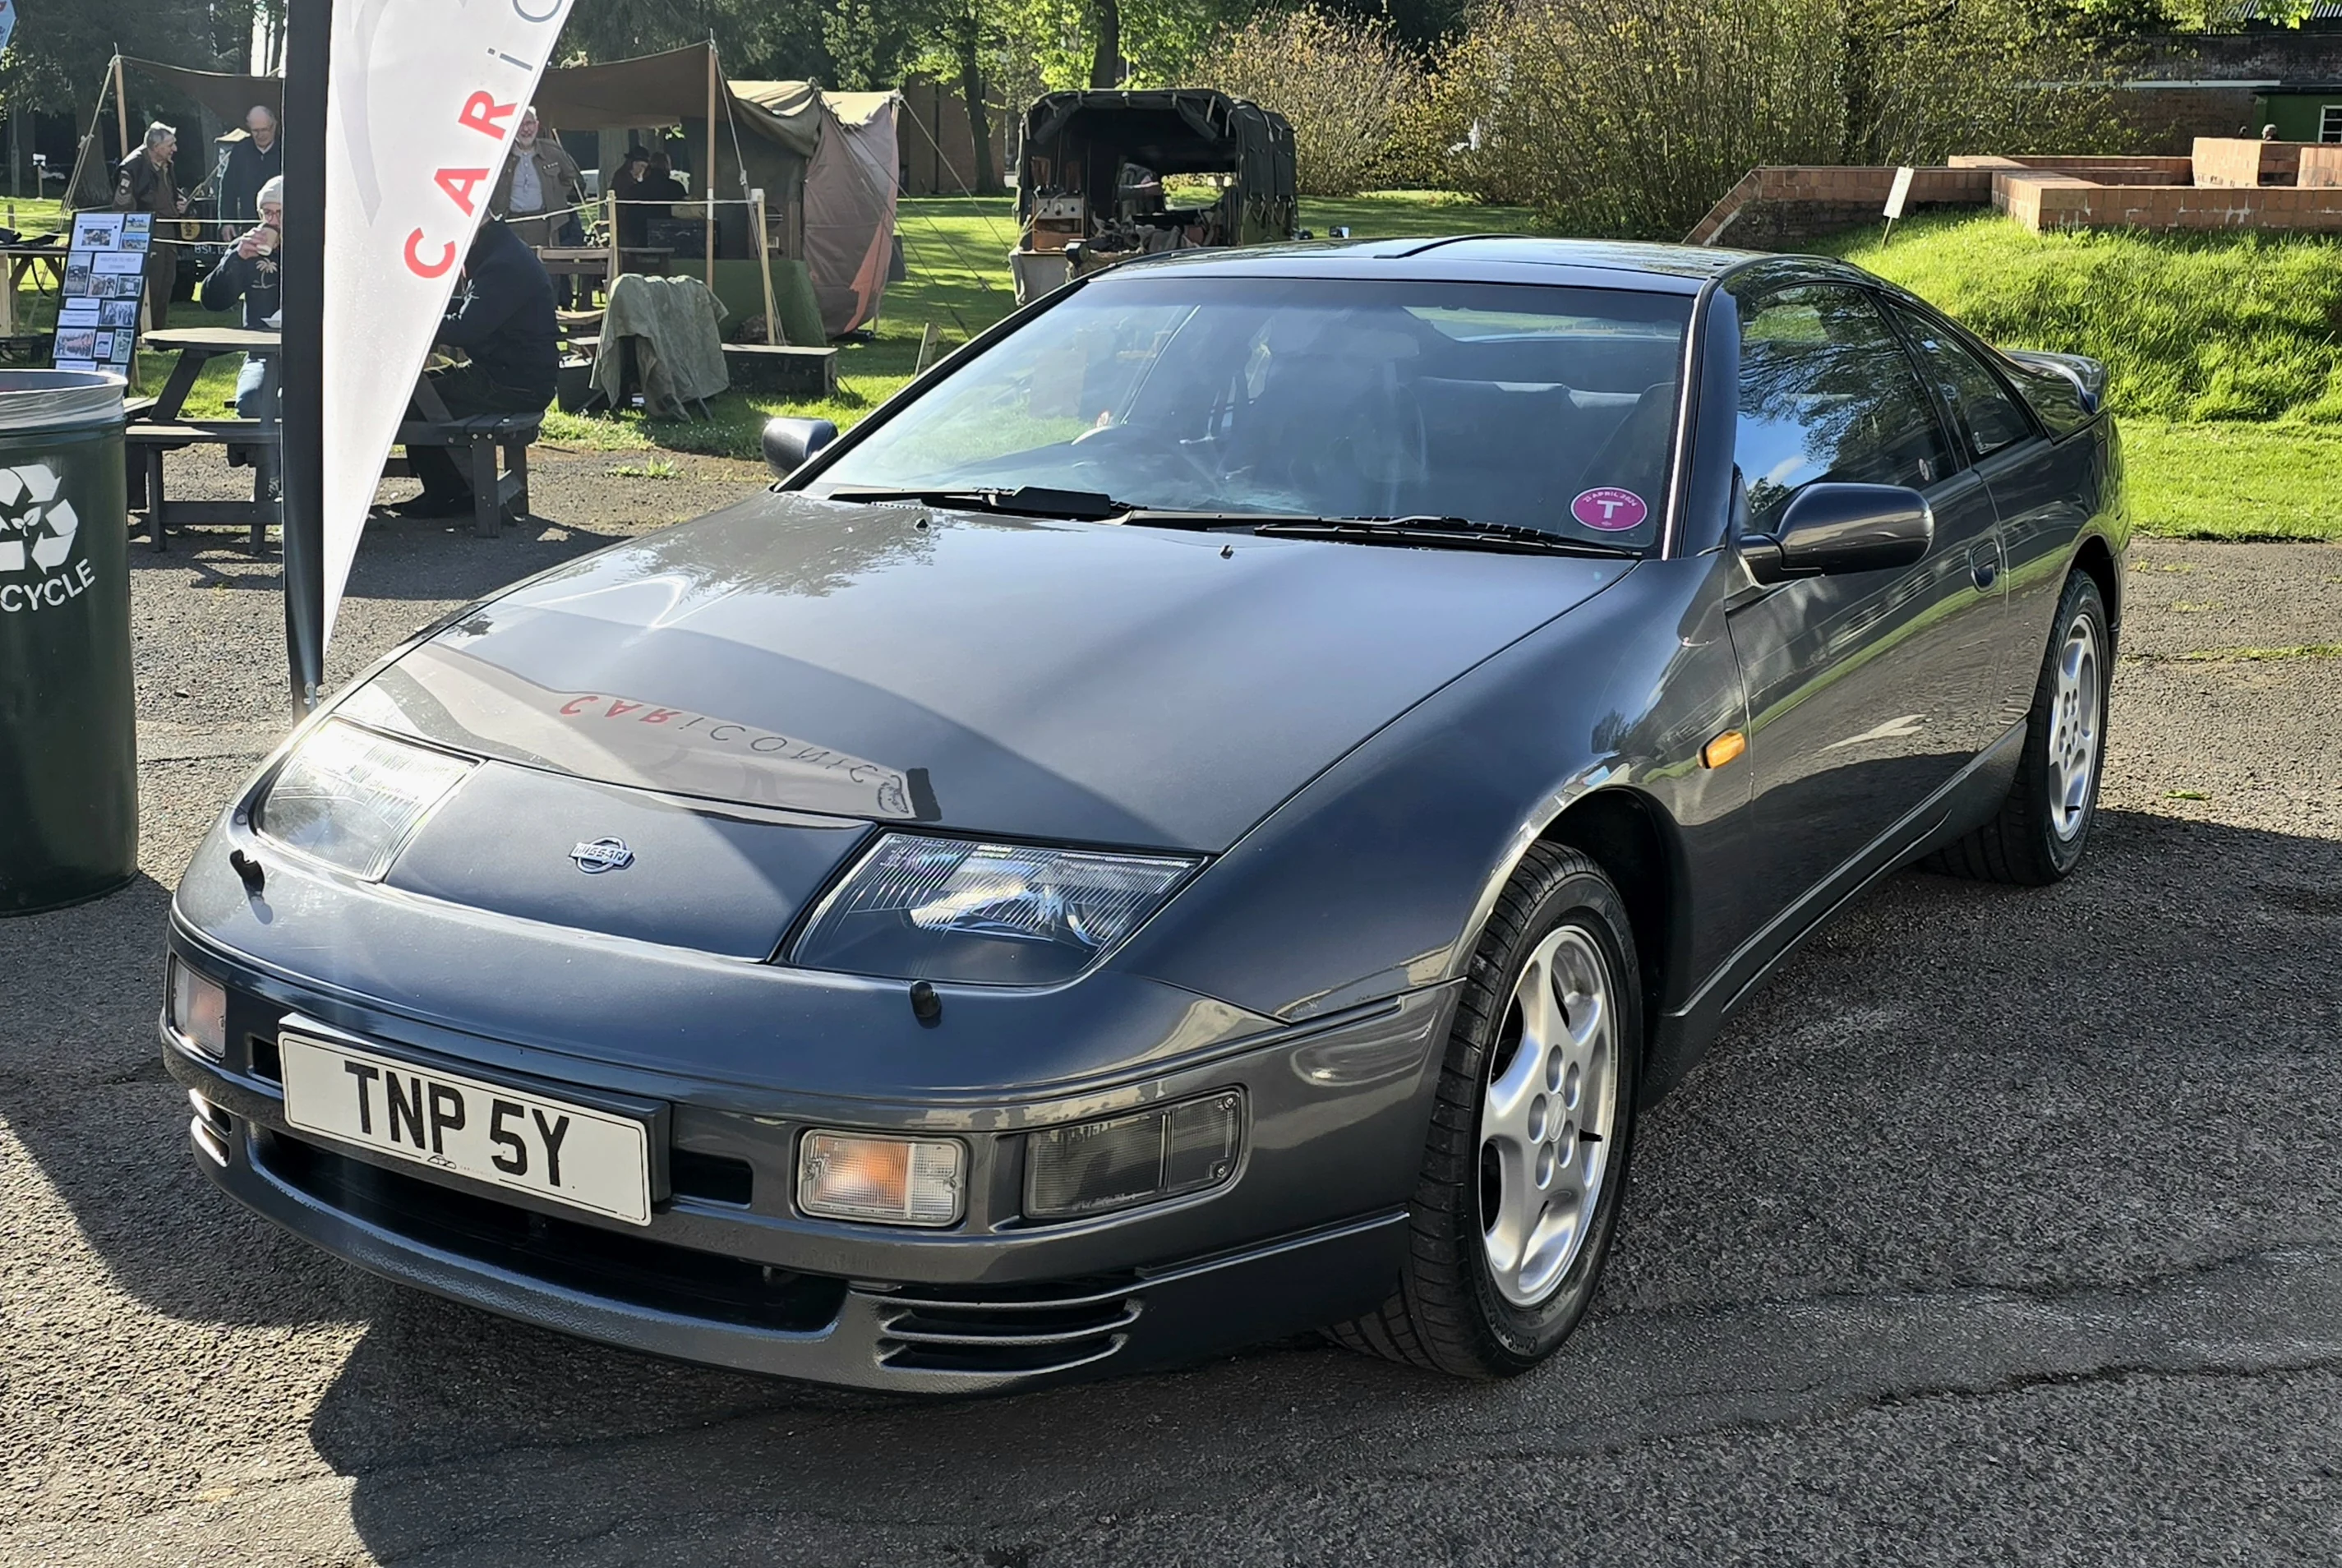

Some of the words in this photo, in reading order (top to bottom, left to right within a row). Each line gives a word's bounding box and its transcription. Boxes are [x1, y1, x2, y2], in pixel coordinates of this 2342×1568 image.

[1597, 500, 1624, 519] T
[0, 558, 95, 612] CYCLE
[572, 844, 629, 863] NISSAN
[344, 1059, 466, 1155] TNP
[490, 1098, 569, 1188] 5Y
